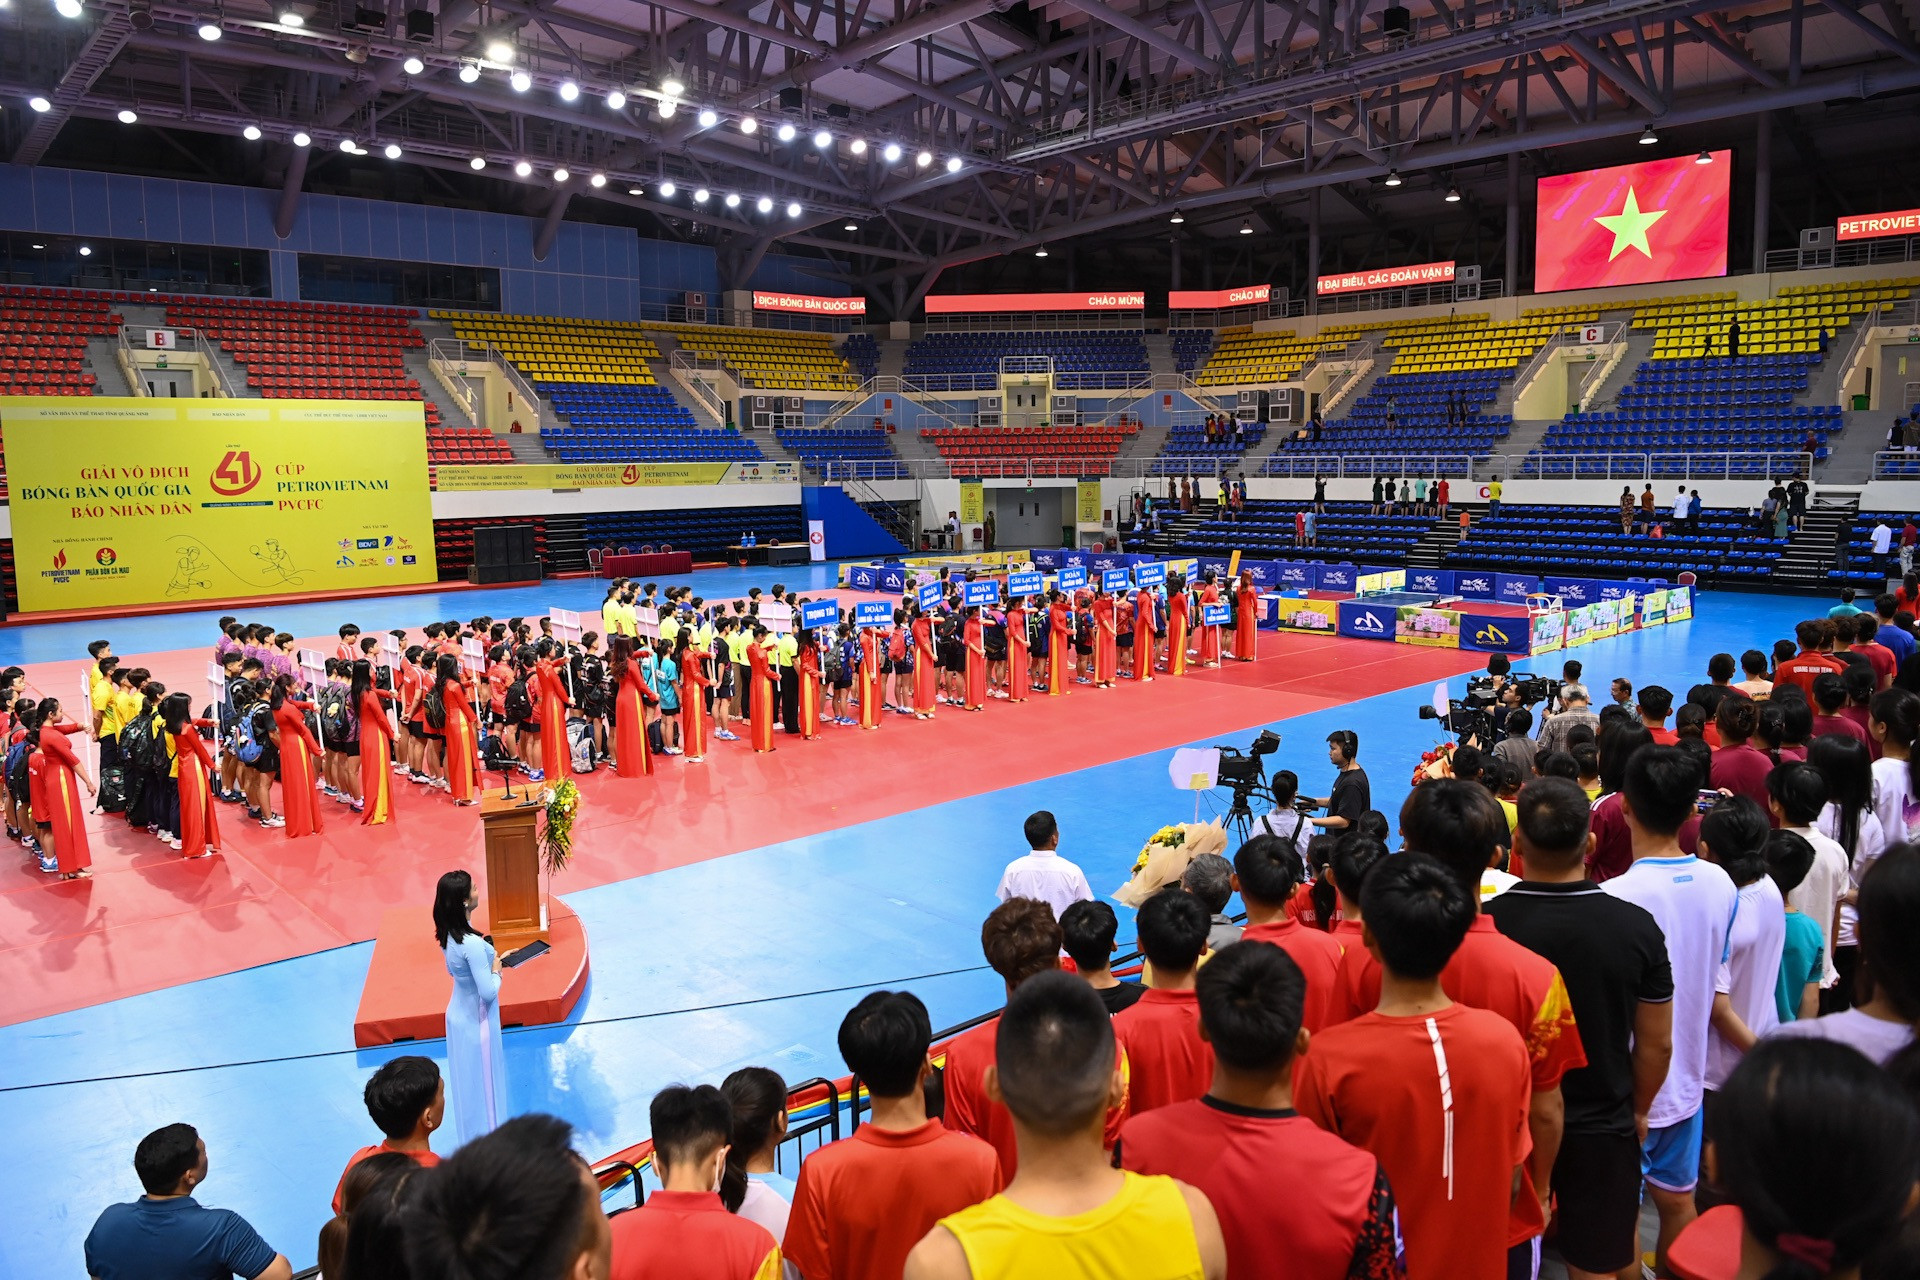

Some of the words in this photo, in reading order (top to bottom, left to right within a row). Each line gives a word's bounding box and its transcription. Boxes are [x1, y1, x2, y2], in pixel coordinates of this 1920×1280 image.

[1324, 279, 1340, 291] ĐẠI
[1368, 271, 1389, 285] CÁC
[1390, 269, 1419, 283] ĐOÀN
[1421, 267, 1442, 280] VẬN
[759, 296, 778, 307] ĐỊCH
[780, 297, 803, 308] BÓNG
[805, 299, 821, 309] BÀN
[849, 301, 866, 310] GIA
[1088, 295, 1116, 306] CHÀO
[1229, 290, 1254, 303] CHÀO
[155, 332, 166, 346] B
[1586, 328, 1597, 341] C
[80, 464, 116, 480] GIẢI
[121, 465, 144, 479] VÔ
[150, 466, 189, 480] ĐỊCH
[216, 451, 252, 484] 41
[275, 462, 305, 476] CÚP
[622, 465, 636, 480] 41
[22, 486, 70, 500] BÓNG
[76, 484, 109, 499] BÀN
[114, 482, 160, 499] QUỐC
[164, 484, 192, 496] GIA
[277, 479, 389, 493] PETROVIETNAM
[71, 504, 104, 519] BÁO
[110, 503, 154, 517] NHÂN
[161, 501, 192, 515] DÂN
[278, 499, 324, 511] PVCFC
[41, 569, 80, 577] PETROVIETNAM
[86, 568, 99, 576] PHÂN
[1064, 570, 1080, 579] ĐOÀN
[1108, 572, 1124, 580] ĐOÀN
[1142, 568, 1159, 576] ĐOÀN
[972, 584, 990, 594] ĐOÀN
[806, 608, 825, 620] TRỌNG
[826, 606, 835, 616] TÀI
[864, 604, 885, 614] ĐOÀN
